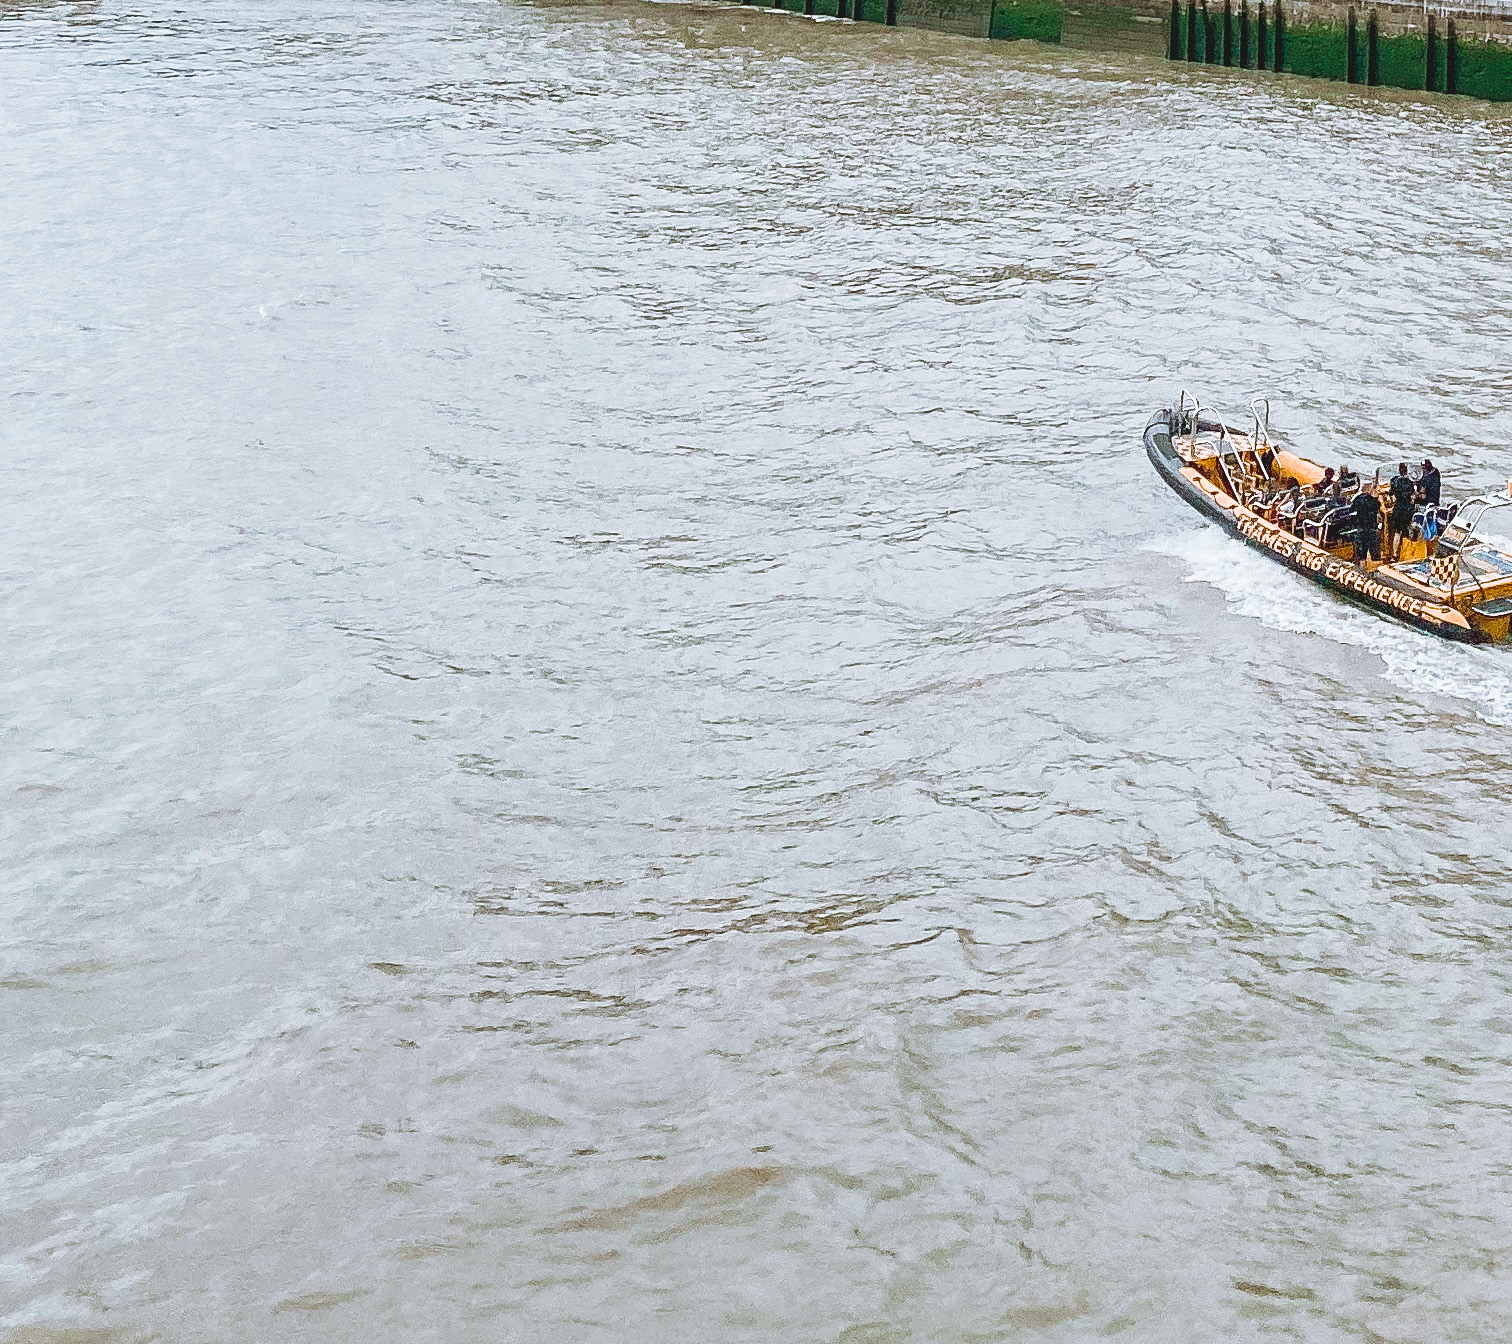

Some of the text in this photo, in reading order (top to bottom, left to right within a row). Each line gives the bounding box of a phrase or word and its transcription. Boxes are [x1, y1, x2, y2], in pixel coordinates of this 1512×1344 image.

[1237, 514, 1424, 617] THAMES RIB EXPERIENCE
